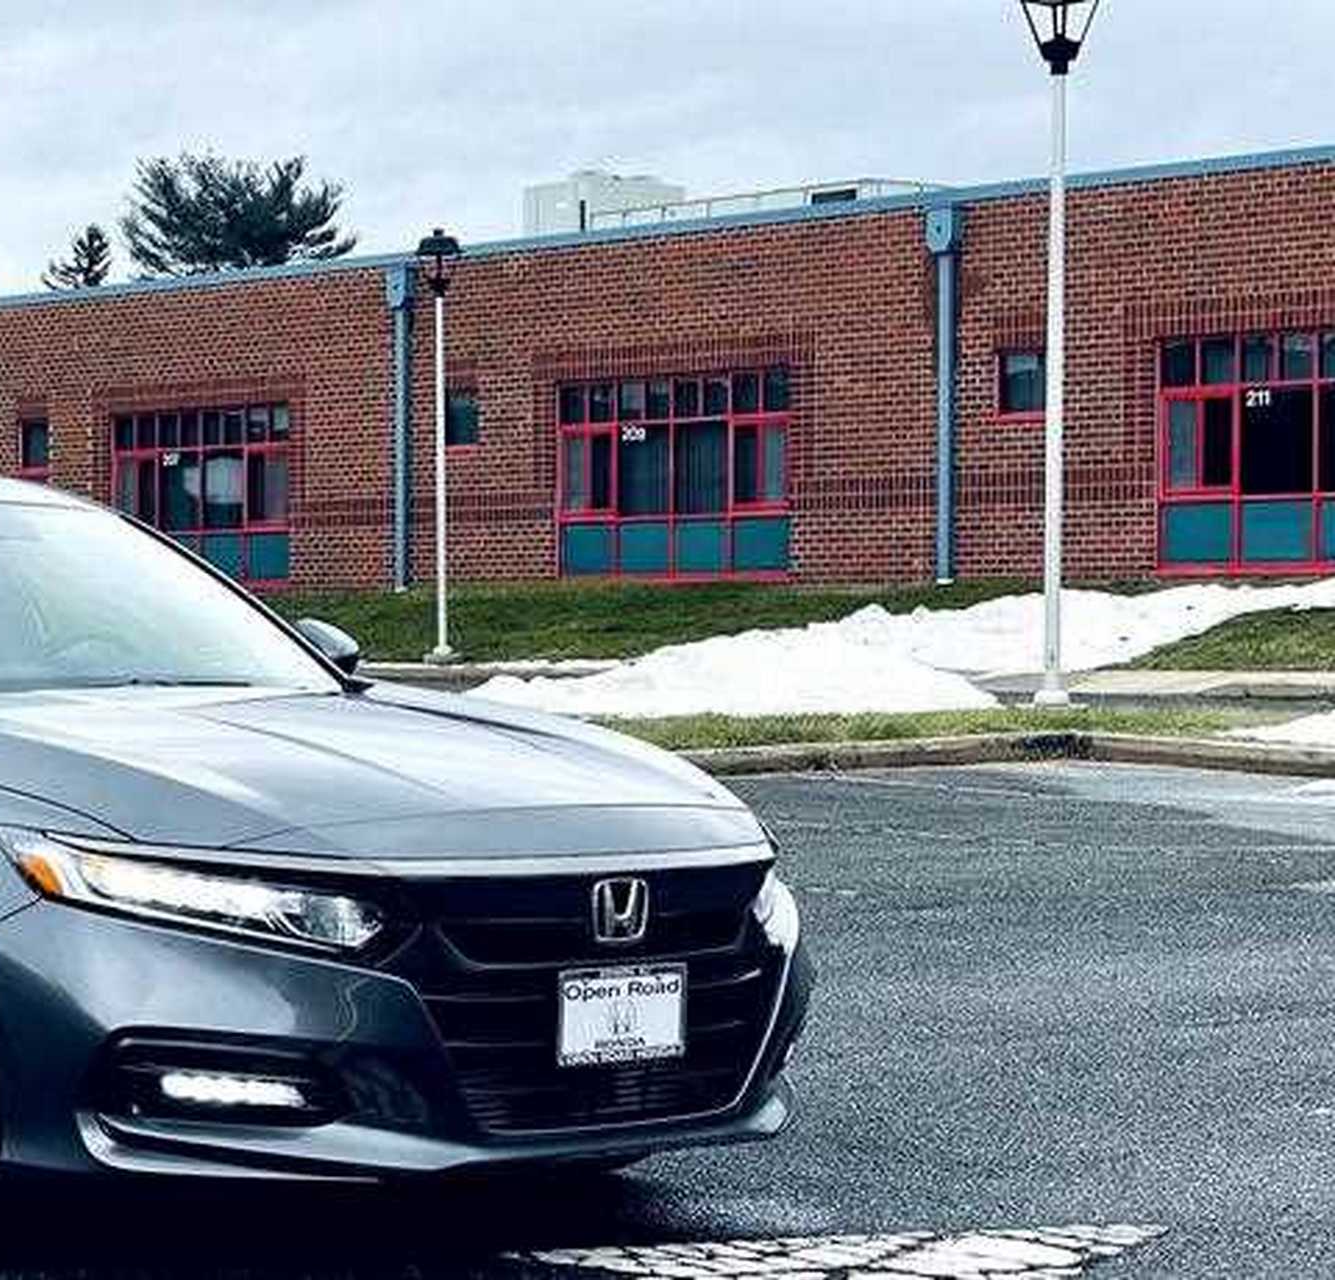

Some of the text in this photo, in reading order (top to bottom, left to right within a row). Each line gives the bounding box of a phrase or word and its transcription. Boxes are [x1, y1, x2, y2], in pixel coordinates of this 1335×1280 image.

[1246, 390, 1270, 407] 211
[622, 424, 646, 441] 209
[565, 979, 679, 1001] Open Road
